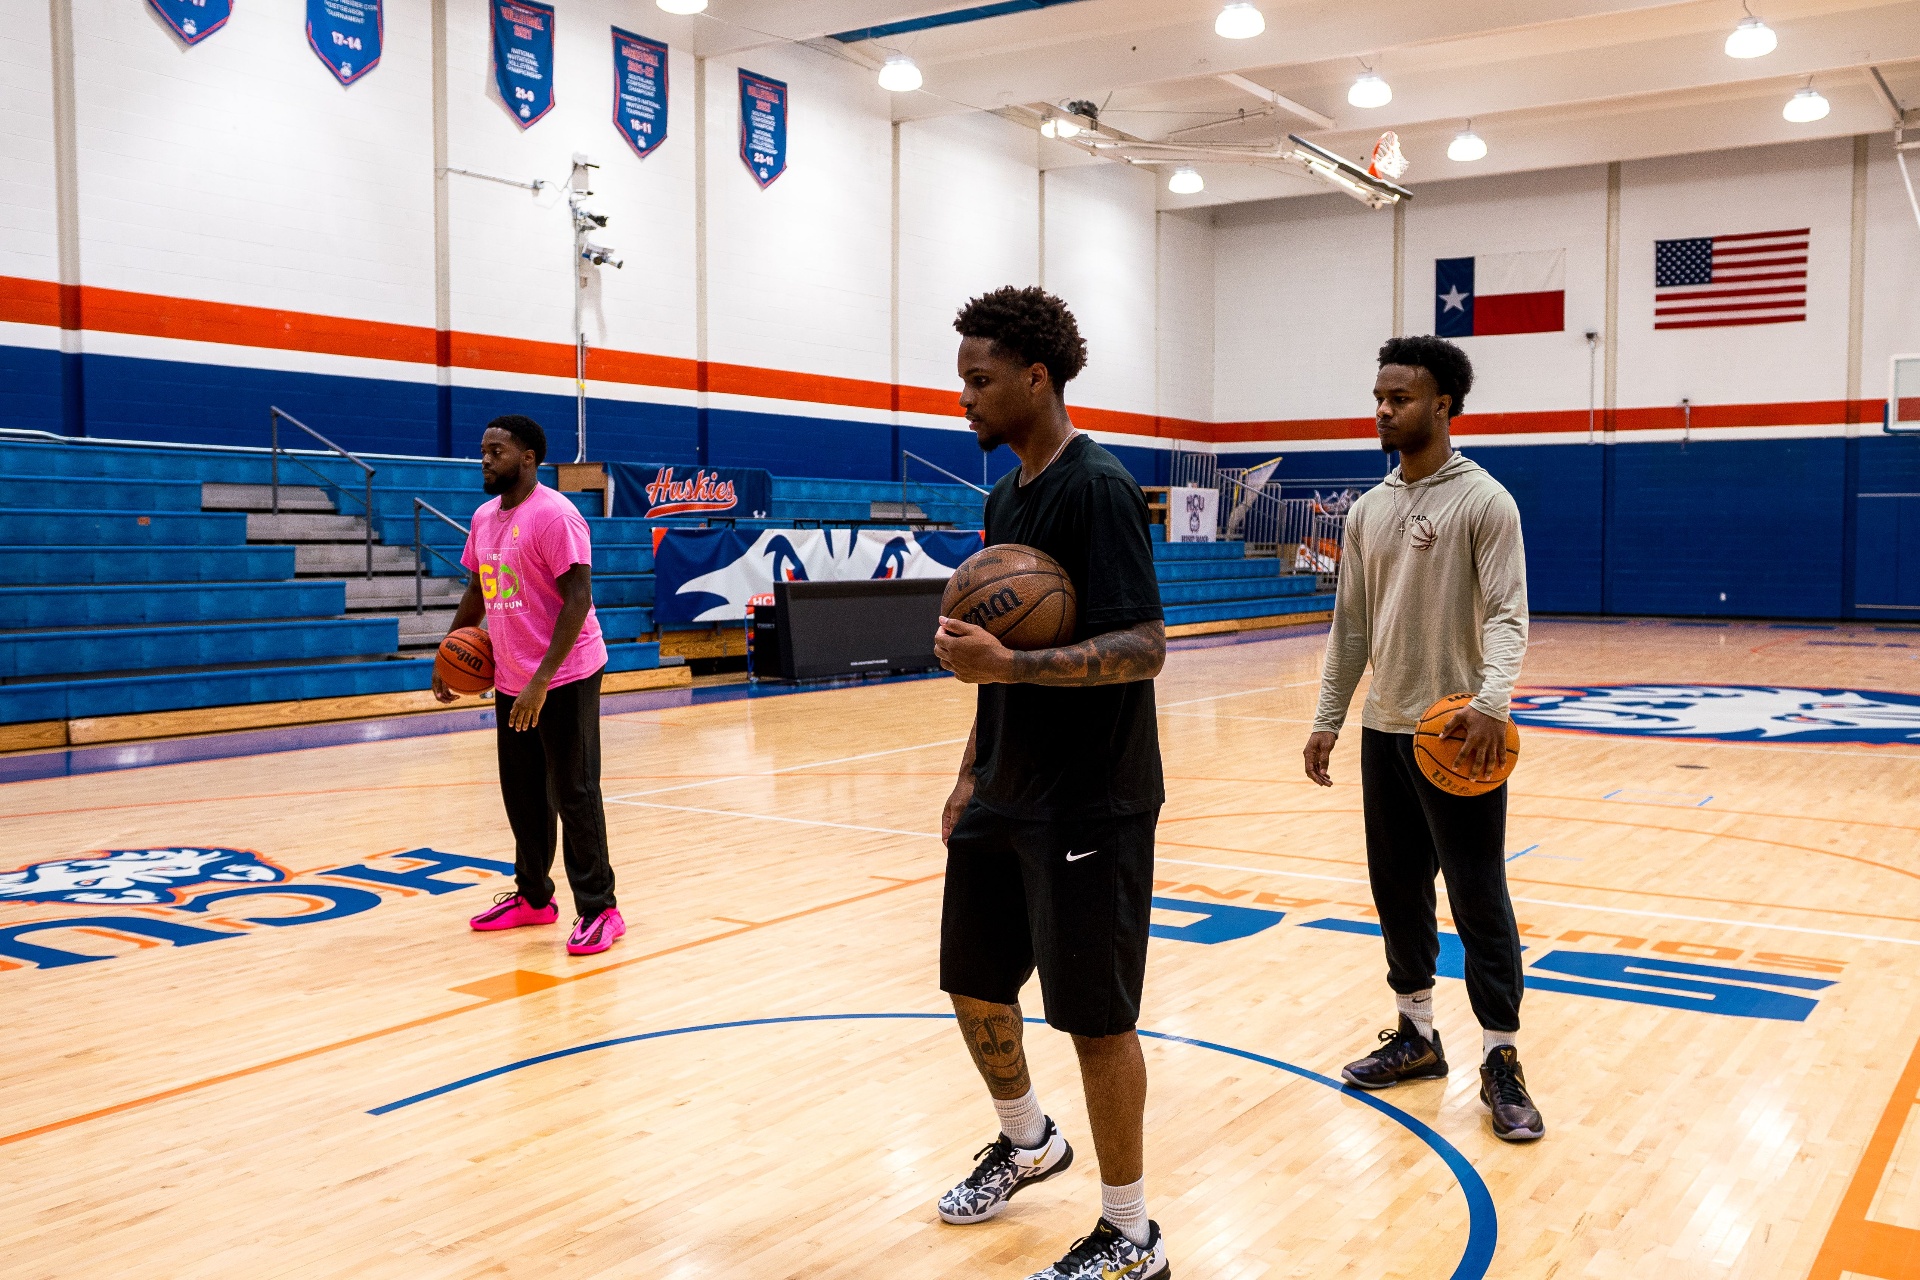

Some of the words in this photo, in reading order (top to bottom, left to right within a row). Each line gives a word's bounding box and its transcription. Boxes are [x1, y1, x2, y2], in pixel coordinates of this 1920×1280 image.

[331, 31, 362, 50] 17-14
[645, 467, 735, 506] Huskies
[445, 641, 483, 672] Wilson
